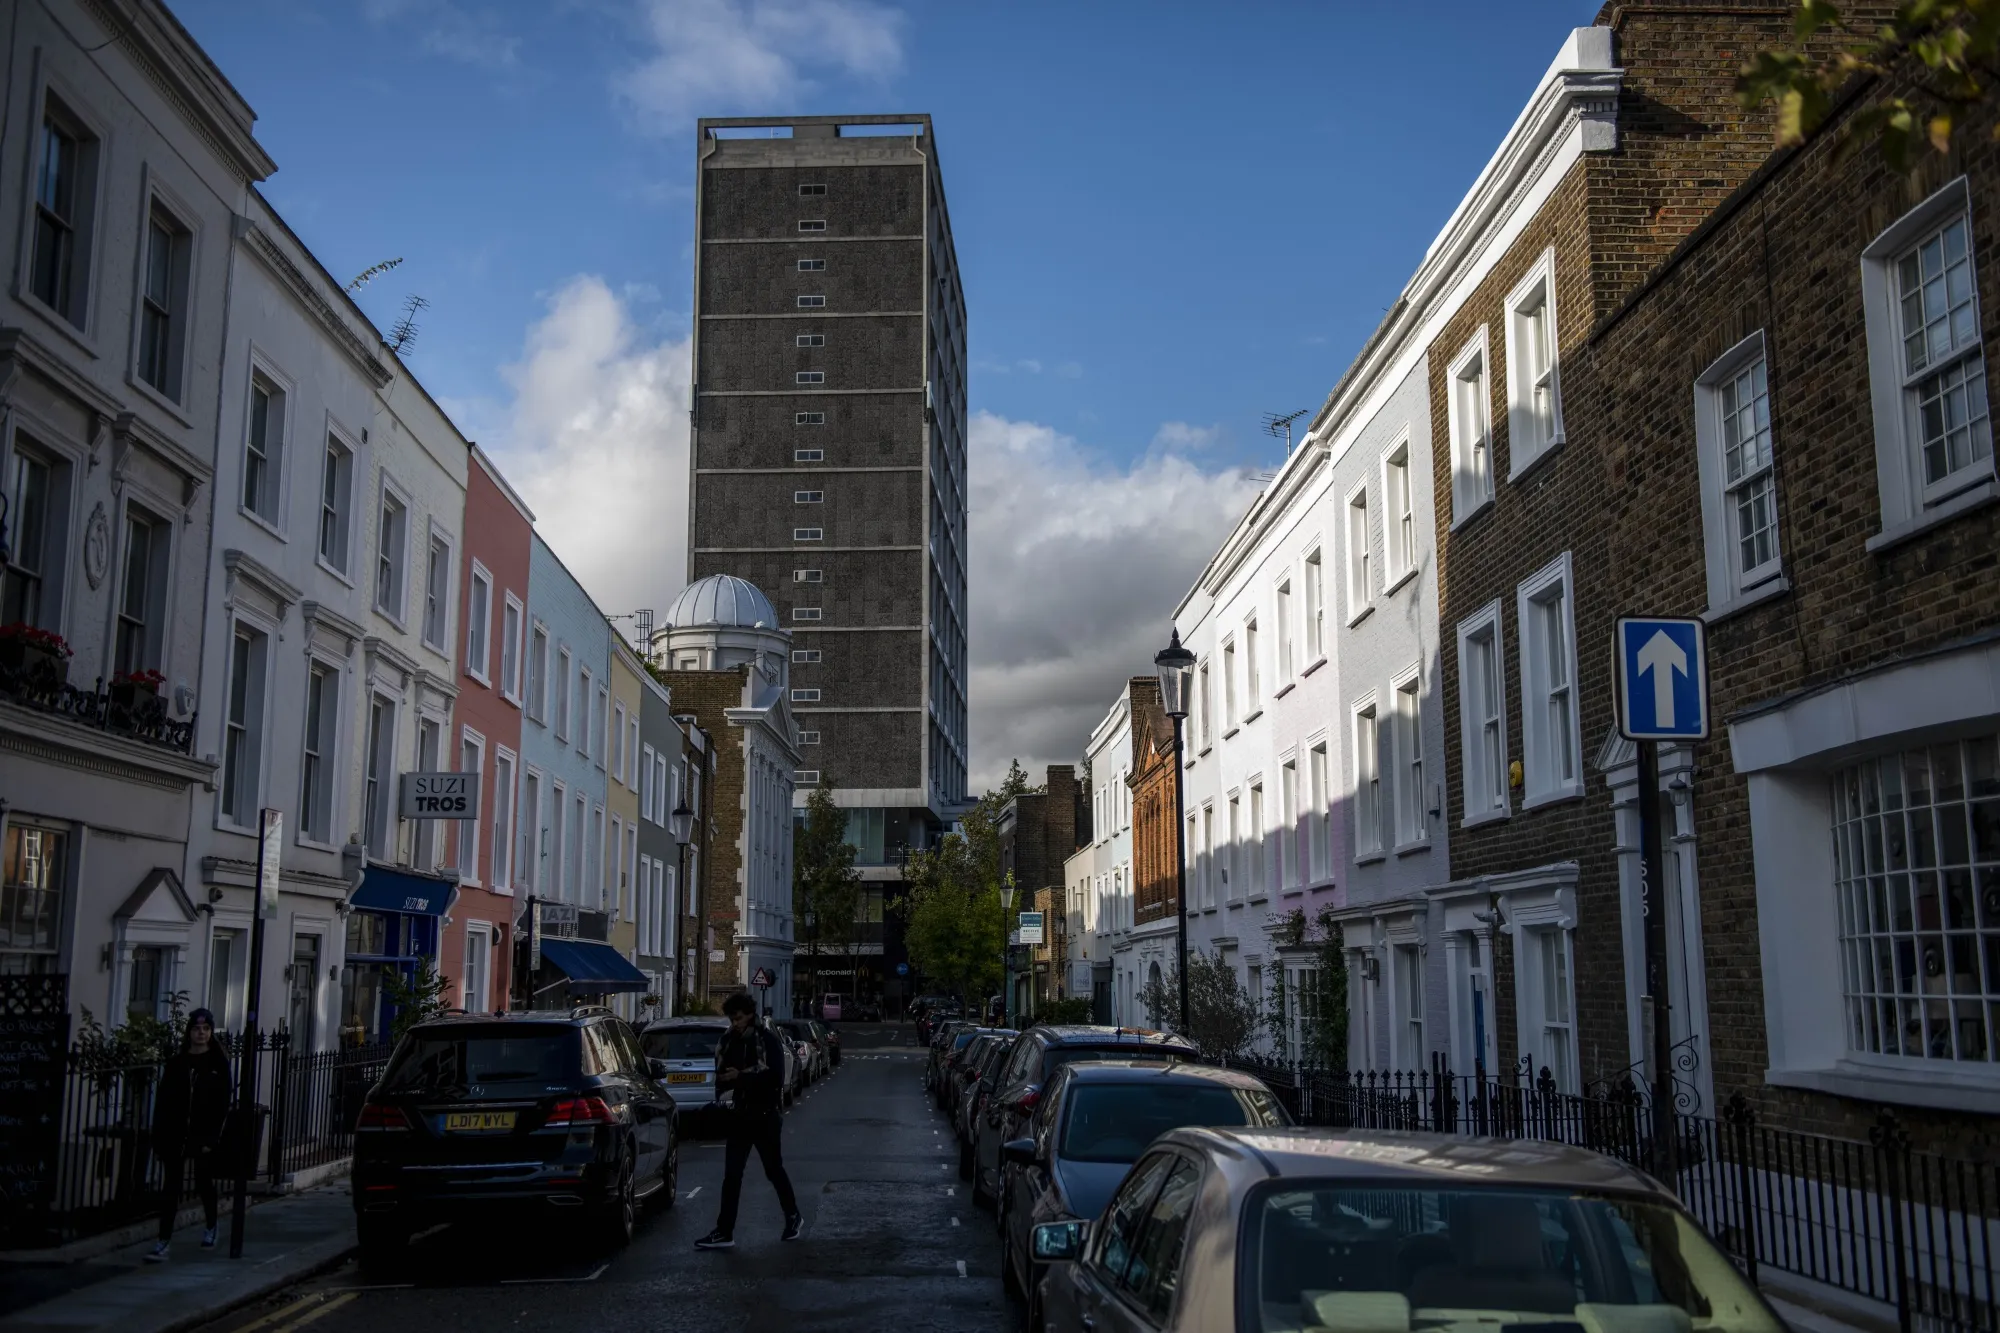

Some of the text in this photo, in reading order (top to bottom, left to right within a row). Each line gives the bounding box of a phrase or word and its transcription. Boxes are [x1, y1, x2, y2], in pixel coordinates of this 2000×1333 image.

[416, 778, 465, 794] SUZI
[415, 796, 466, 811] TROS
[451, 1114, 509, 1128] LD17 WYL
